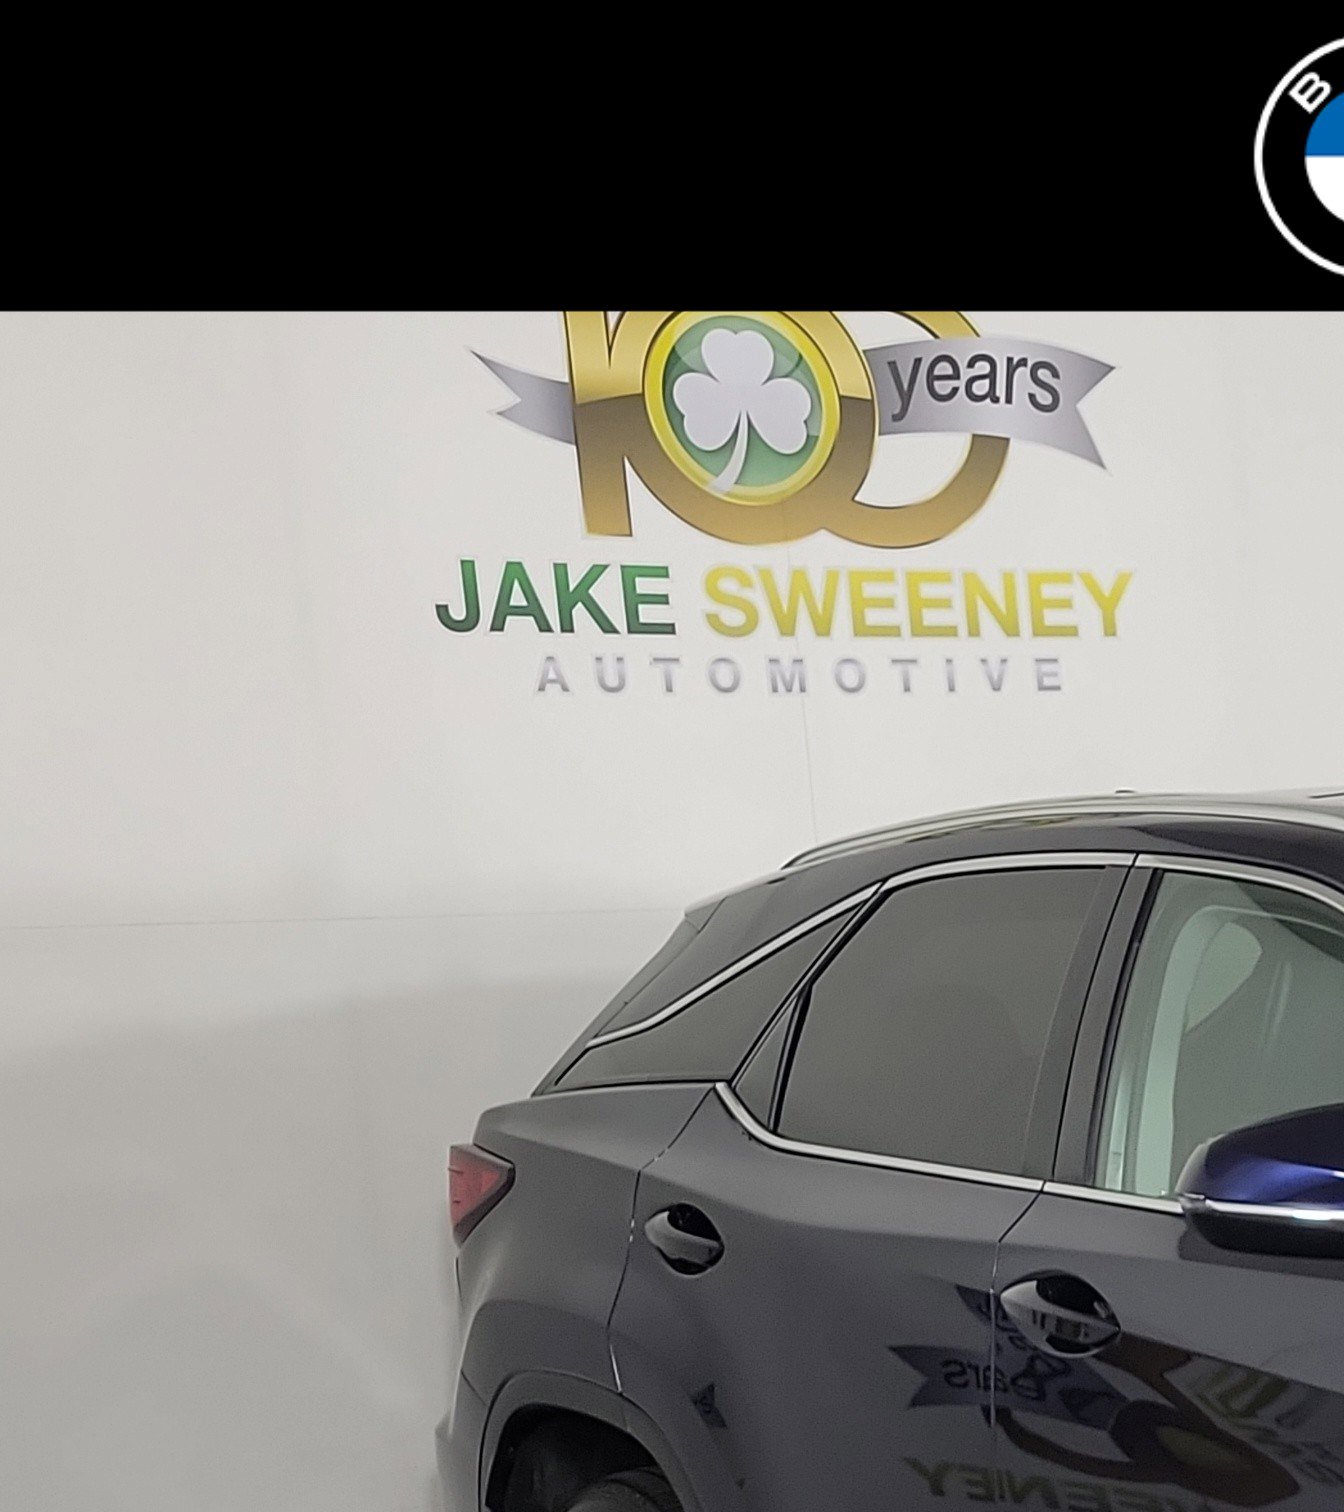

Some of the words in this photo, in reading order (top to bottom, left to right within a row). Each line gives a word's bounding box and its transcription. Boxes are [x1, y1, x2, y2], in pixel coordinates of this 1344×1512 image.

[887, 354, 1060, 421] years
[435, 559, 677, 636] JAKE
[704, 566, 1132, 637] SWEENEY
[536, 656, 1062, 694] AUTOMOTIVE
